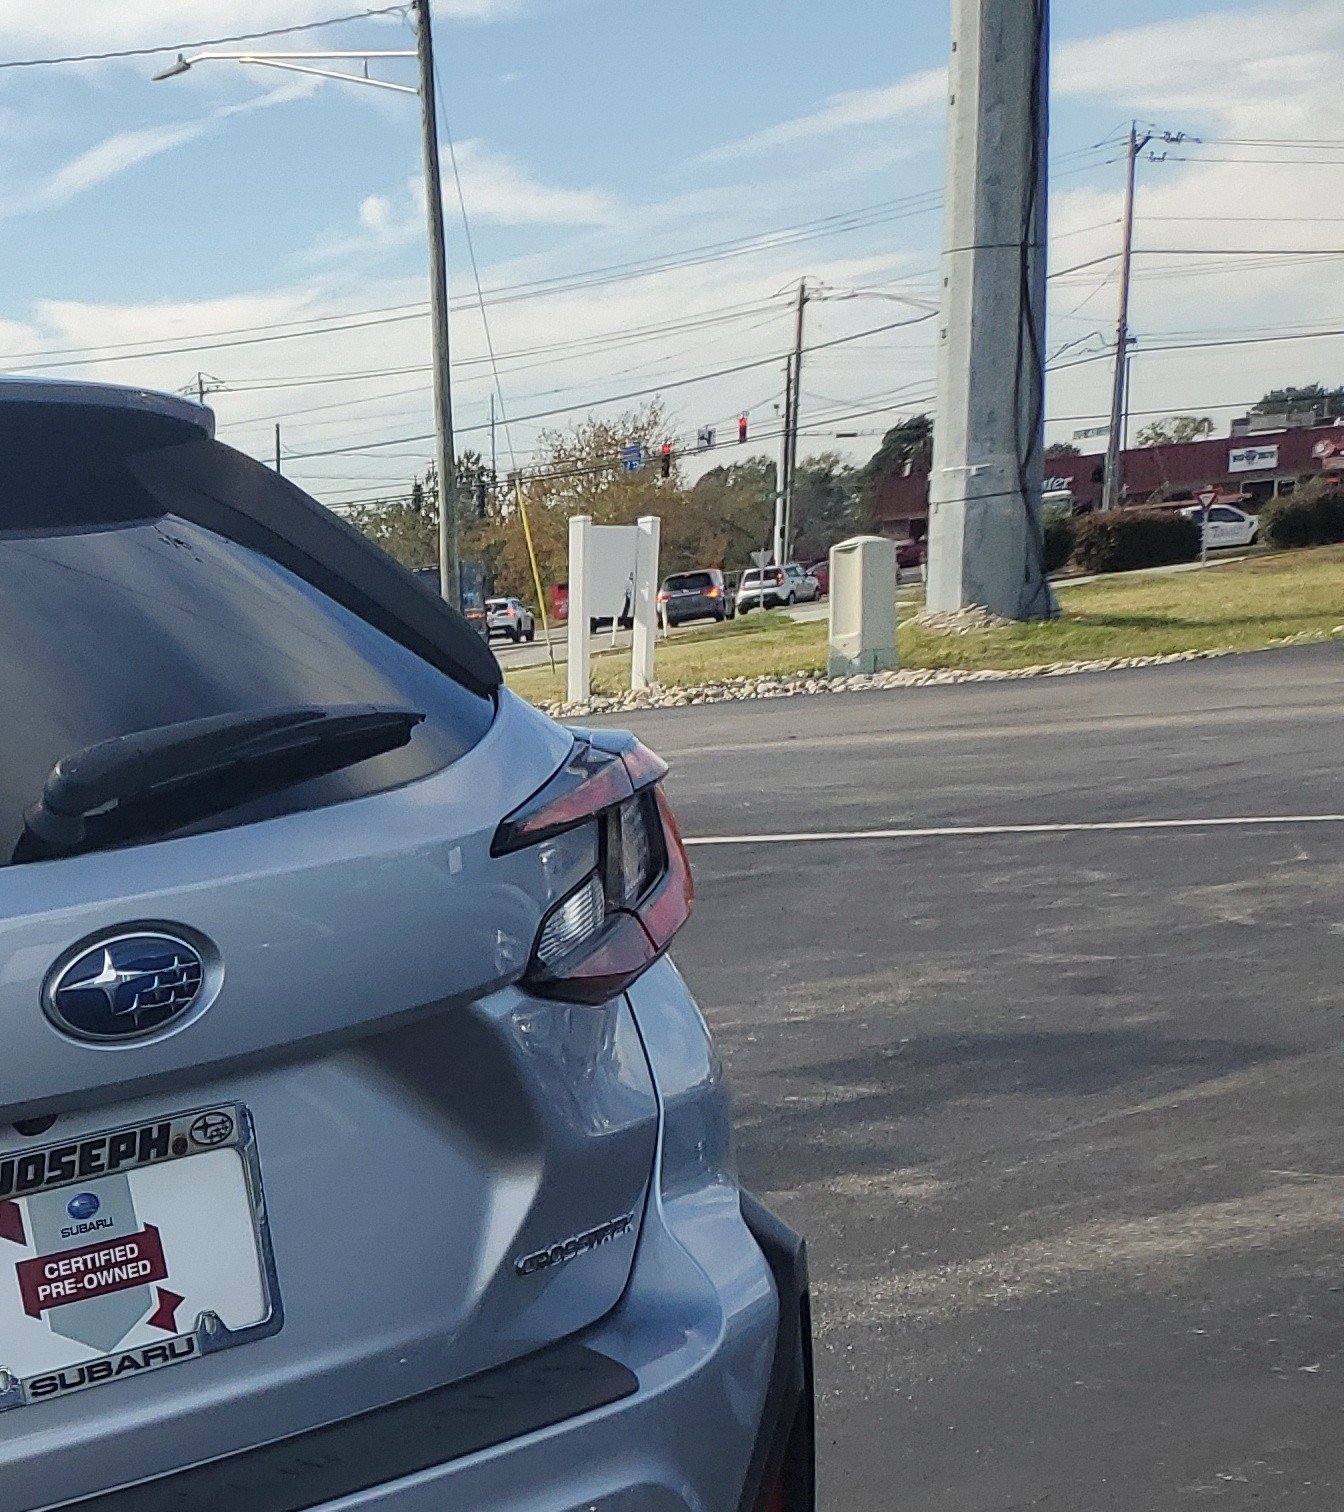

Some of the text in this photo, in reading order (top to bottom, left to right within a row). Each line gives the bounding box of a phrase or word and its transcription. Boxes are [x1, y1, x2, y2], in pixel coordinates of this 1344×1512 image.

[60, 1216, 114, 1239] SUBARU
[44, 1243, 139, 1279] CERTIFIED
[37, 1260, 151, 1301] PRE-OWNED
[28, 1336, 195, 1398] SUBARU
